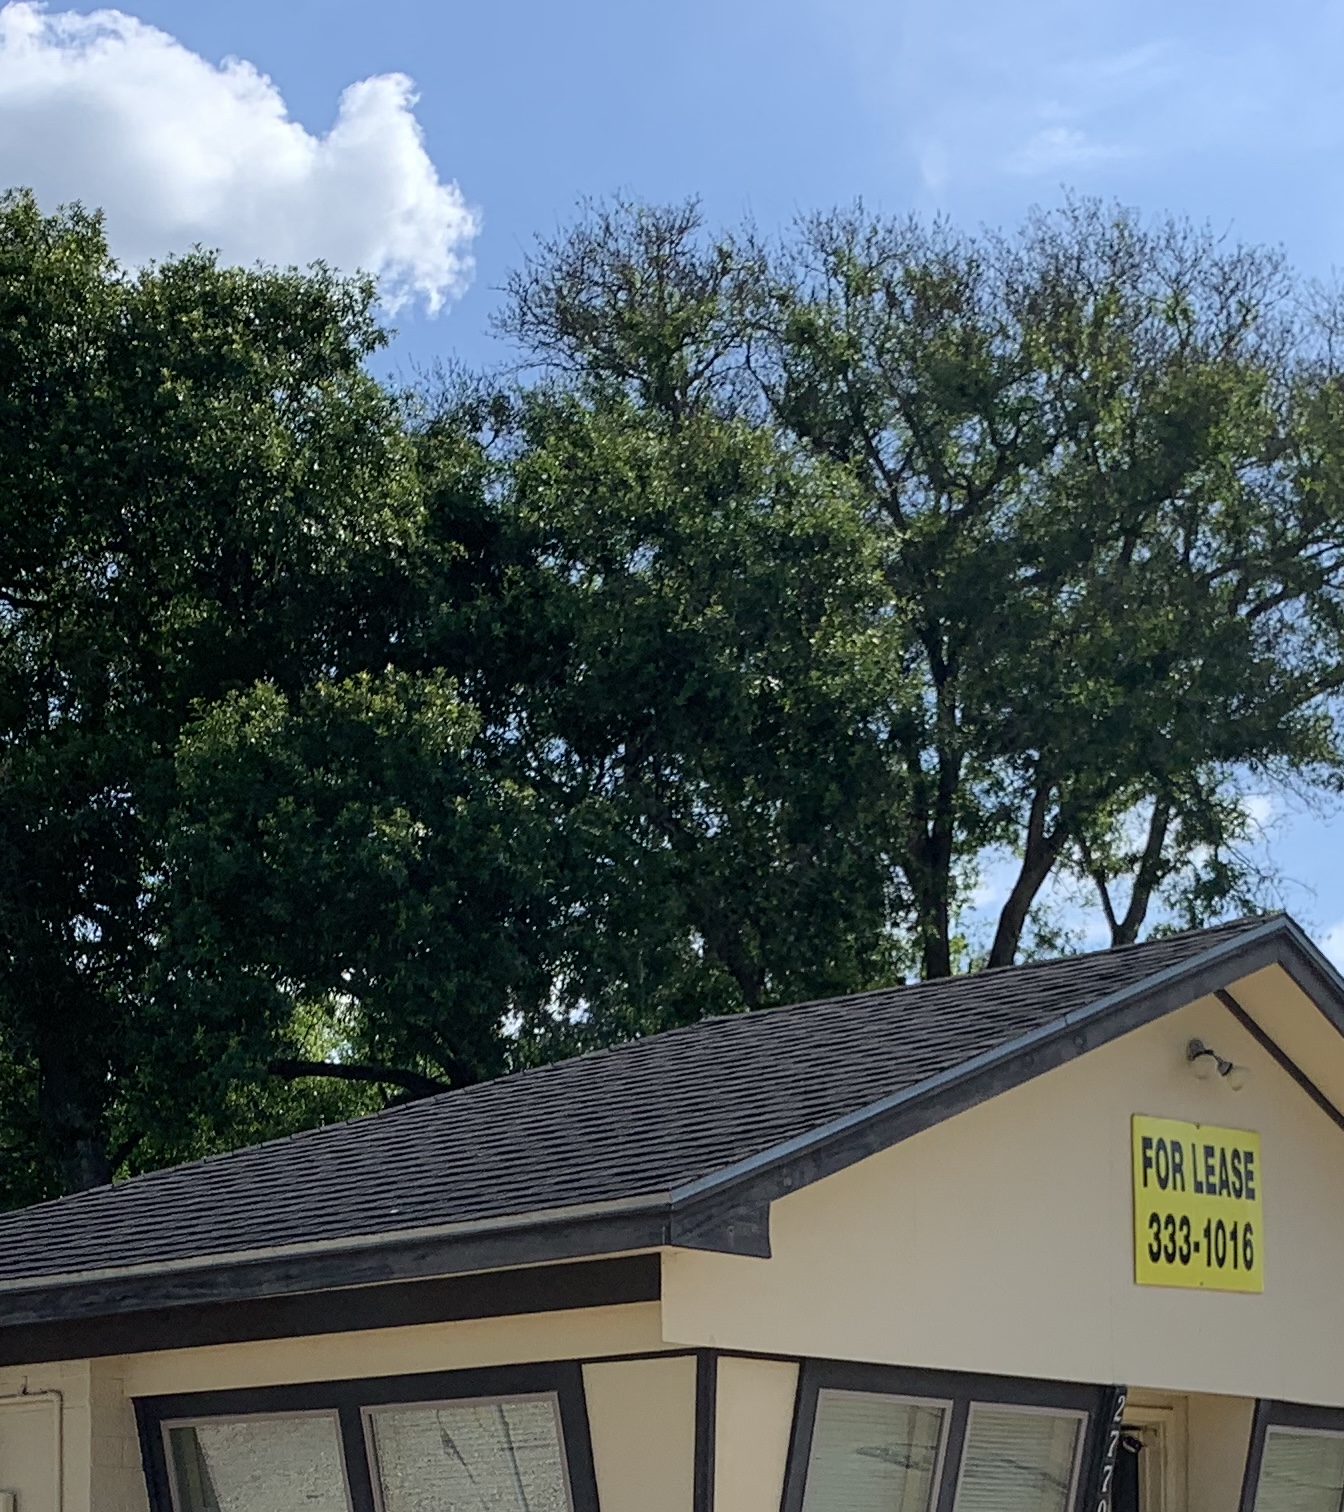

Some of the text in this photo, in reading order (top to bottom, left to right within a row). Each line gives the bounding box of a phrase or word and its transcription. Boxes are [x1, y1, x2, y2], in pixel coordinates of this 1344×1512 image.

[1141, 1136, 1256, 1201] FOR LEASE
[1148, 1212, 1254, 1271] 333-1016
